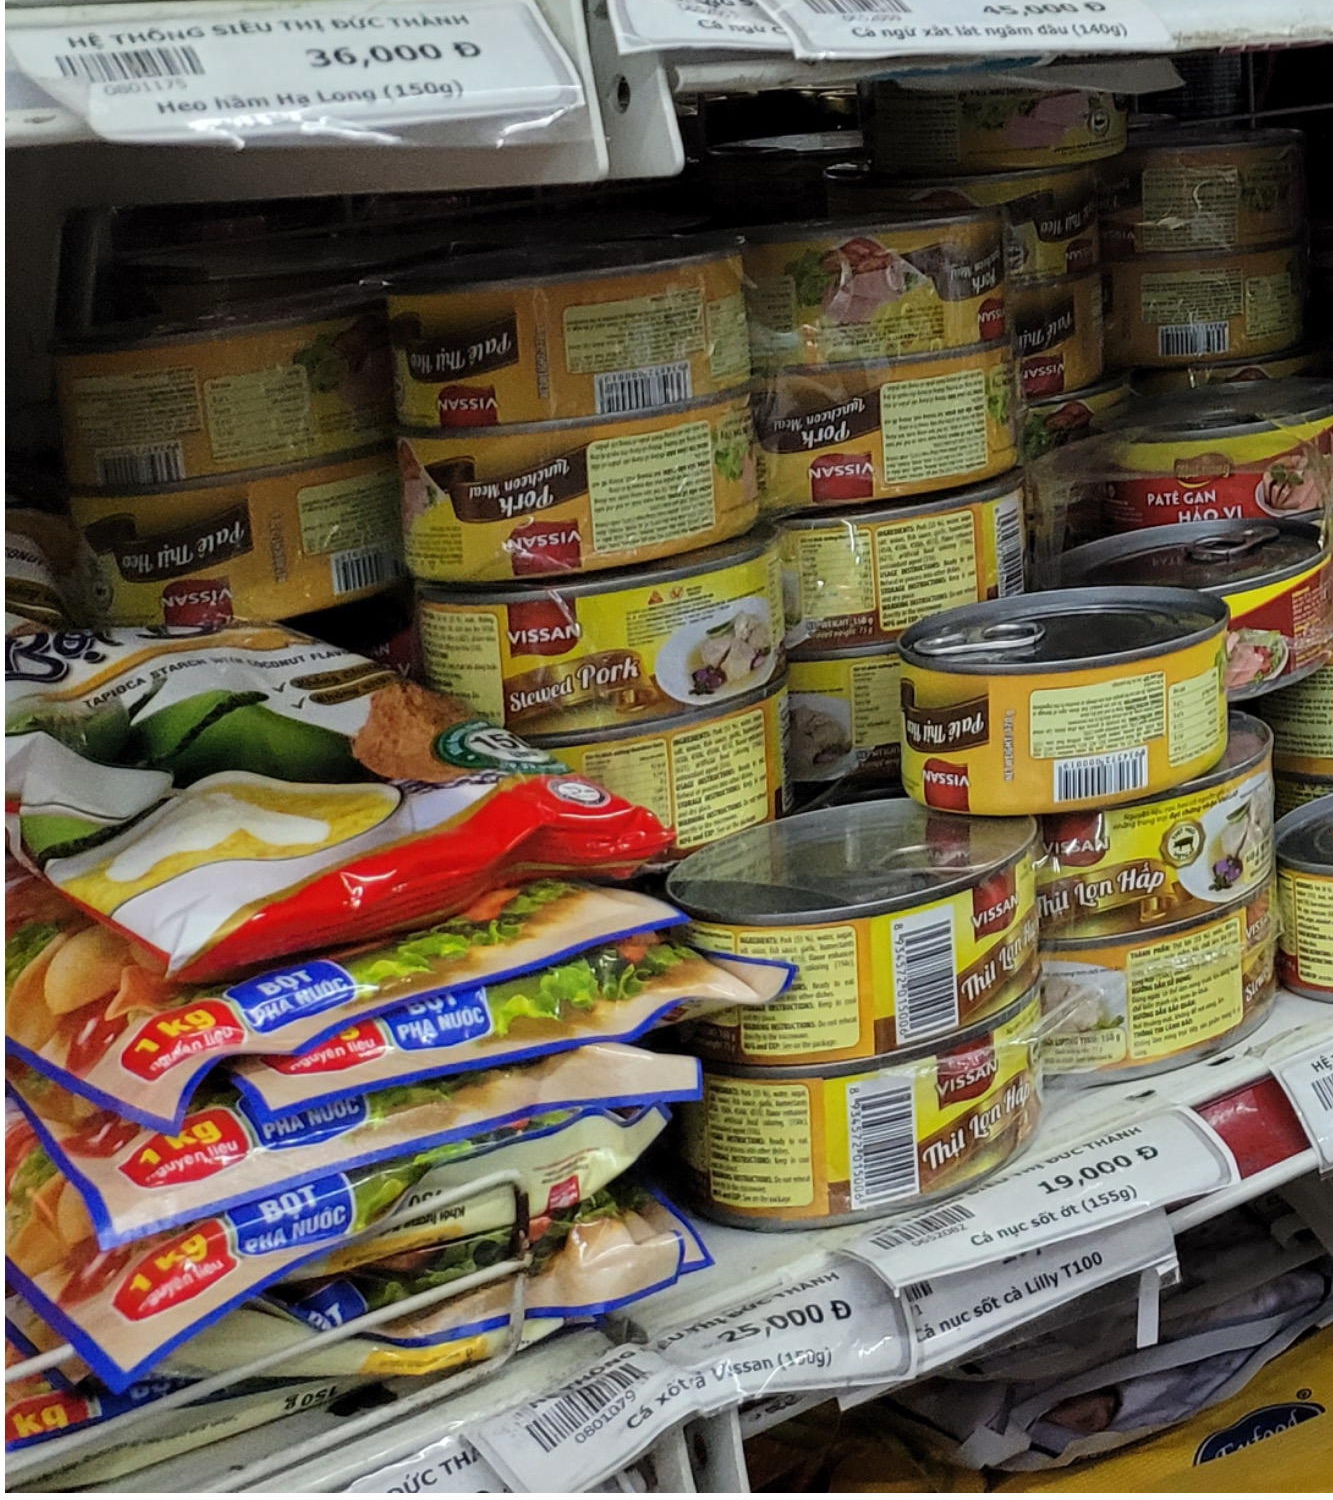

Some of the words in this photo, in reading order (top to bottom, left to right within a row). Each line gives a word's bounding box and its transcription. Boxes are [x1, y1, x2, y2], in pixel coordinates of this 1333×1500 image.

[305, 42, 443, 70] 36,000
[454, 41, 481, 58] Đ
[157, 100, 208, 116] Heo
[278, 92, 310, 109] Hạ
[319, 87, 377, 106] Long
[384, 80, 464, 100] (150g)
[1183, 489, 1218, 505] GAN
[502, 529, 582, 555] VISSAN
[507, 621, 583, 646] VISSAN
[85, 678, 146, 709] TAPIOCA
[150, 659, 207, 679] STARCH
[509, 676, 574, 713] Stewed
[575, 654, 640, 695] Pork
[1042, 837, 1111, 857] VISSAN
[1089, 880, 1114, 907] Lợn
[1117, 860, 1166, 897] Hấp
[156, 1009, 217, 1037] kg
[1311, 1053, 1333, 1073] HỆ
[1037, 1154, 1133, 1195] 19,000
[1136, 1145, 1159, 1162] Đ
[971, 1231, 994, 1247] Cá
[996, 1221, 1029, 1240] nục
[1031, 1210, 1059, 1229] sốt
[1060, 1201, 1080, 1219] ớt
[1082, 1184, 1138, 1214] (155g)
[938, 1312, 972, 1336] nục
[973, 1295, 1002, 1319] sốt
[1003, 1284, 1024, 1304] cà
[1025, 1269, 1060, 1298] Lilly
[1060, 1251, 1104, 1280] T100
[716, 1302, 825, 1344] 25,000
[831, 1299, 852, 1320] Đ
[574, 1388, 638, 1445] 0801079
